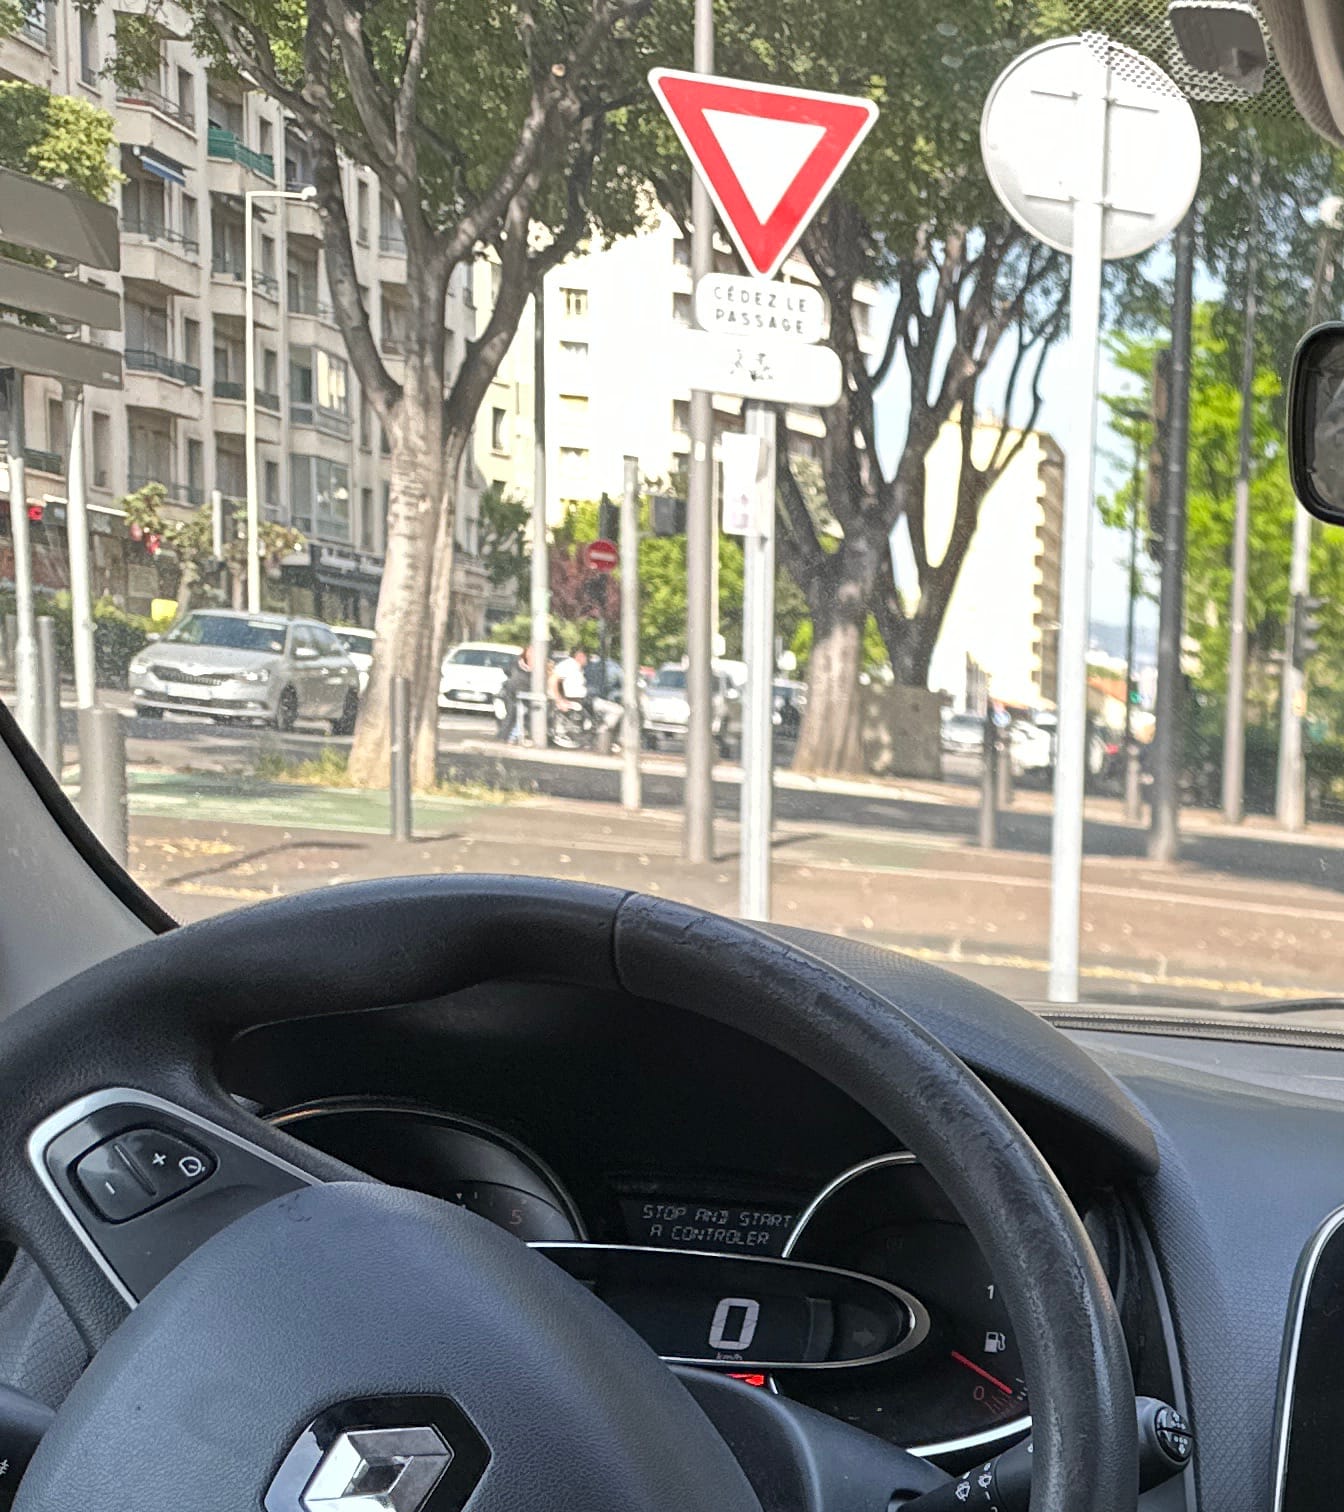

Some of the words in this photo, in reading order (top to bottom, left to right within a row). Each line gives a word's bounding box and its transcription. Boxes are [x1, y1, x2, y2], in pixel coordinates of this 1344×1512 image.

[787, 297, 807, 312] LE
[715, 308, 804, 334] PASSAGE
[642, 1204, 686, 1221] STOP
[694, 1208, 728, 1224] AND
[738, 1211, 792, 1228] START
[650, 1224, 663, 1237] A
[670, 1227, 770, 1246] CONTROLER
[708, 1297, 760, 1351] 0
